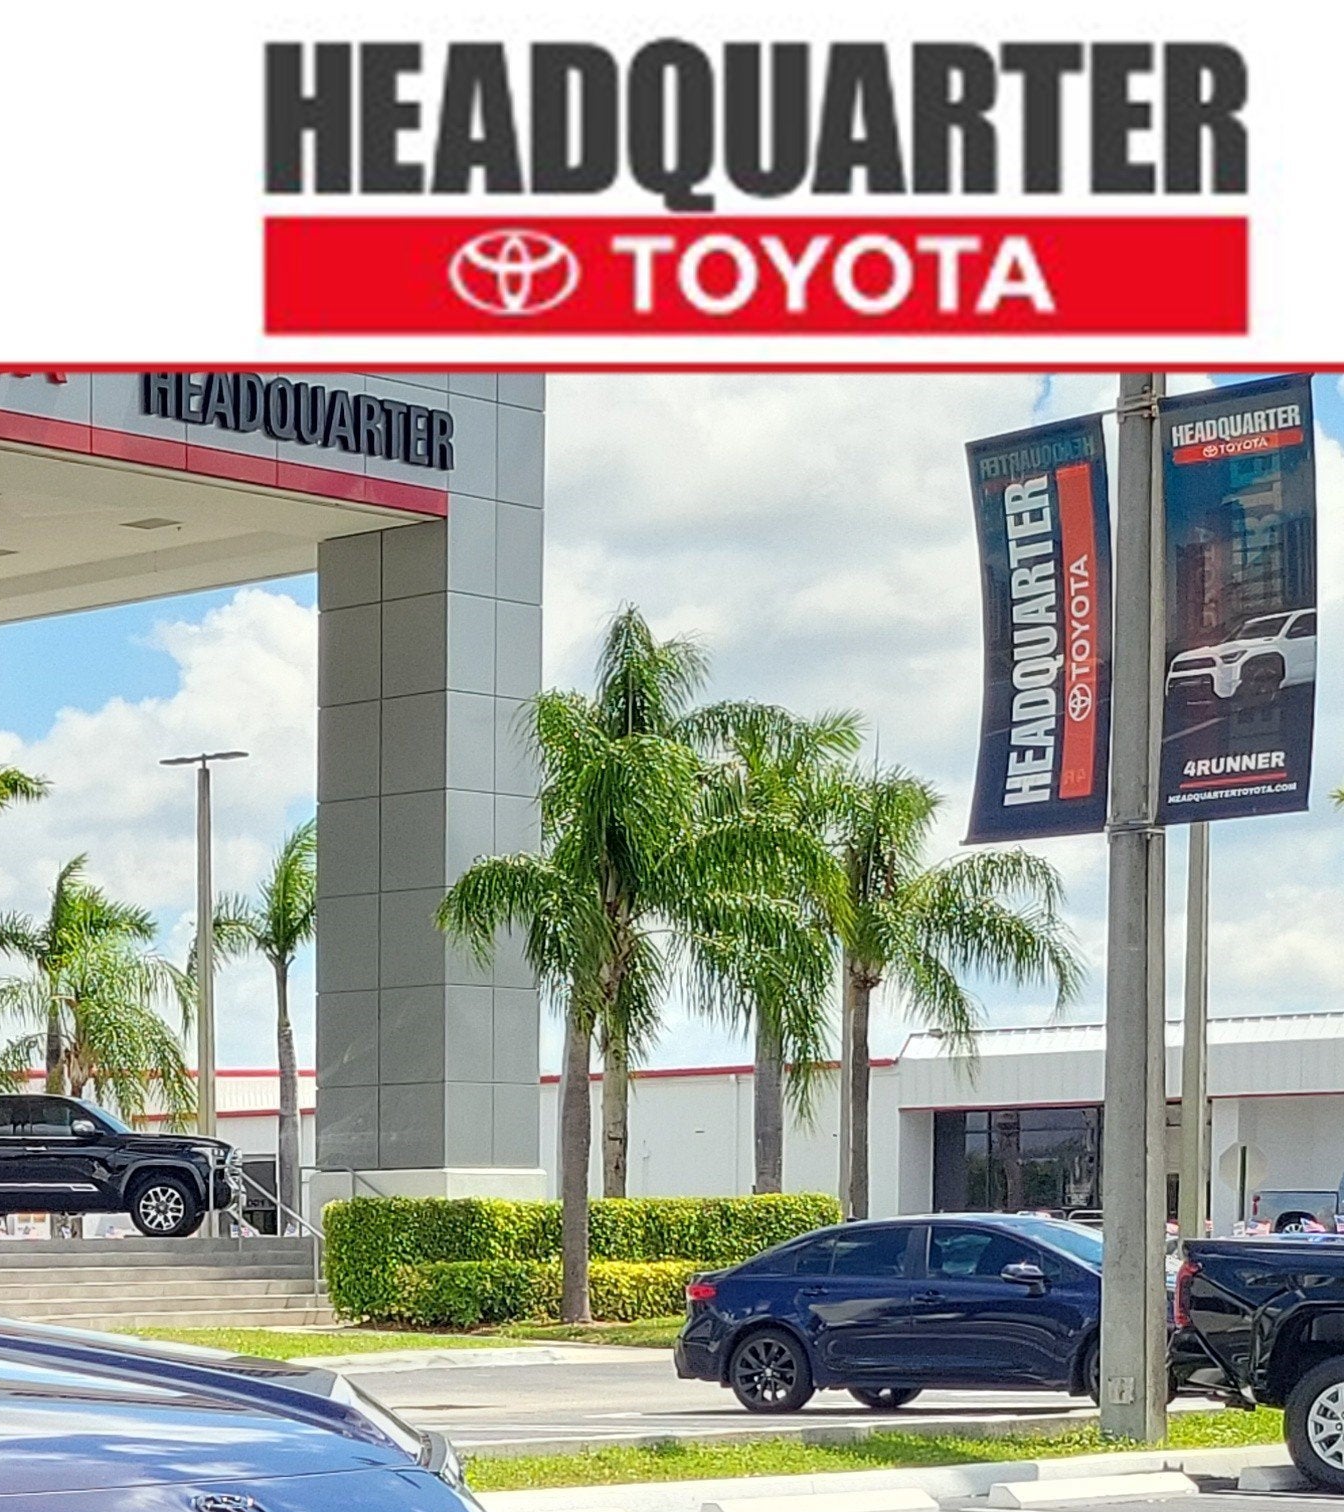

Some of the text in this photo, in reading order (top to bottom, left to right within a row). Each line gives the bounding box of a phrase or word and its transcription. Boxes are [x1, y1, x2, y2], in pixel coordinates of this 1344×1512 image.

[141, 372, 454, 470] HEADQUARTER
[1171, 404, 1301, 447] HEADQUARTER
[1218, 436, 1269, 454] TOYOTA
[1069, 554, 1091, 681] TOYOTA
[1003, 473, 1064, 806] HEADQUARTER
[1183, 751, 1286, 777] 4RUNNER
[1167, 781, 1297, 804] HEADQUARTERTOYOTA.COM
